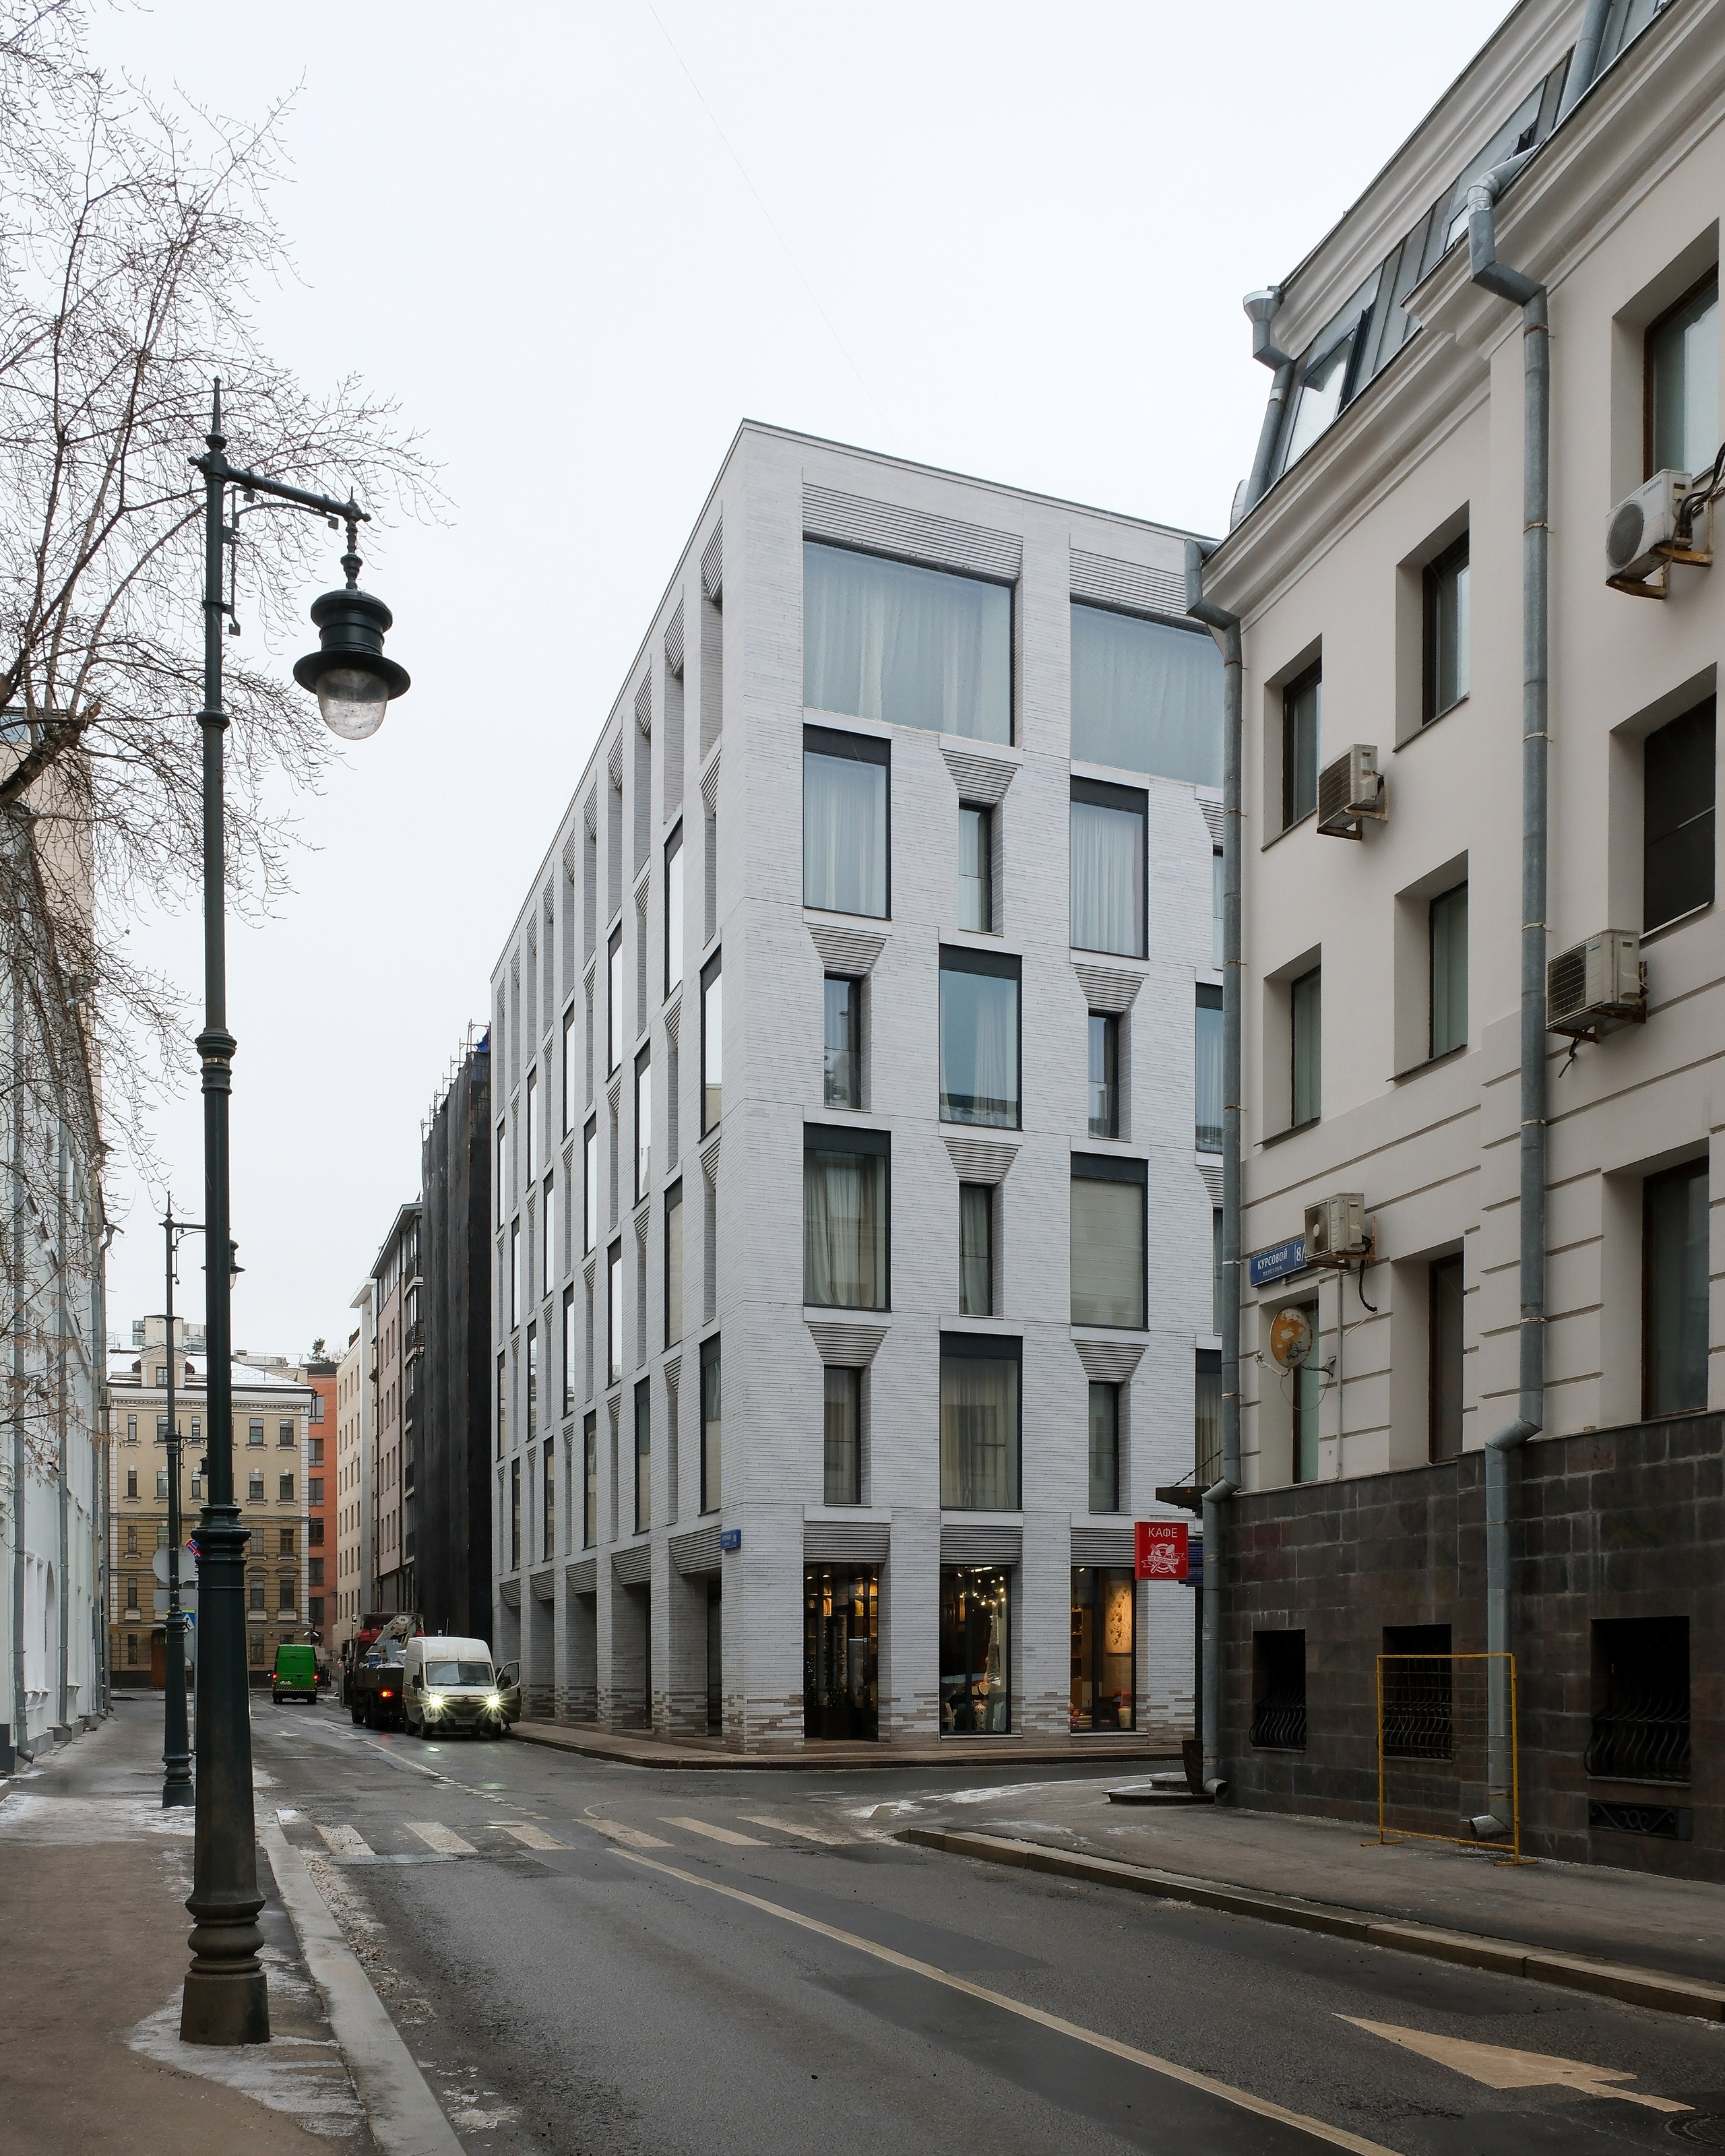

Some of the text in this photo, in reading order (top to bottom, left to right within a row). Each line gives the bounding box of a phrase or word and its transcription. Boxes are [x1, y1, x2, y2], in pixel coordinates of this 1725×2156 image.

[1257, 1248, 1288, 1271] КУРСОВОЙ
[1262, 1265, 1283, 1277] ПЕРЕУЛОК
[1148, 1527, 1178, 1538] КАФЕ
